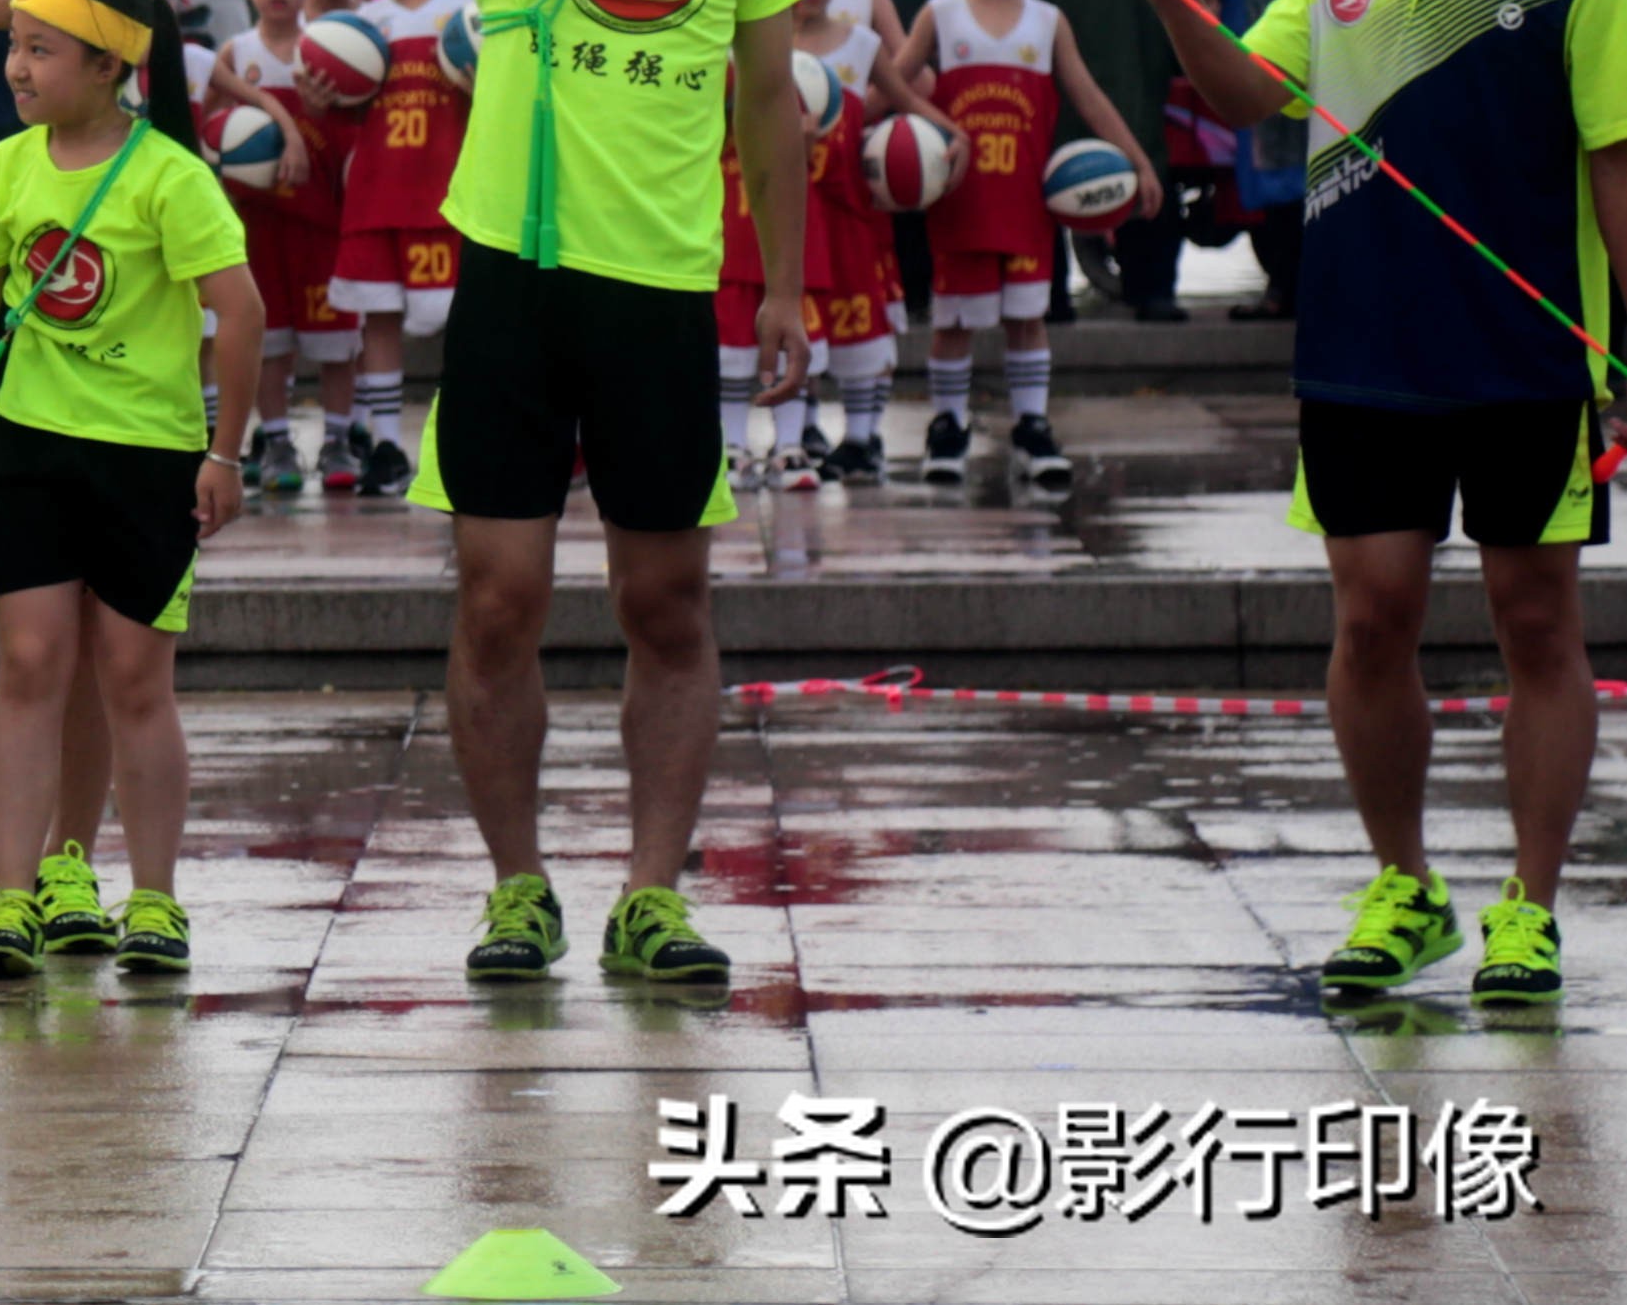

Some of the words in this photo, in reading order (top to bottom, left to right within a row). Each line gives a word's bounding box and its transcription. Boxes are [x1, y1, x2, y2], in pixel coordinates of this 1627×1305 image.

[386, 108, 428, 148] 20
[976, 133, 1016, 175] 30
[407, 242, 451, 283] 20
[829, 294, 872, 338] 23
